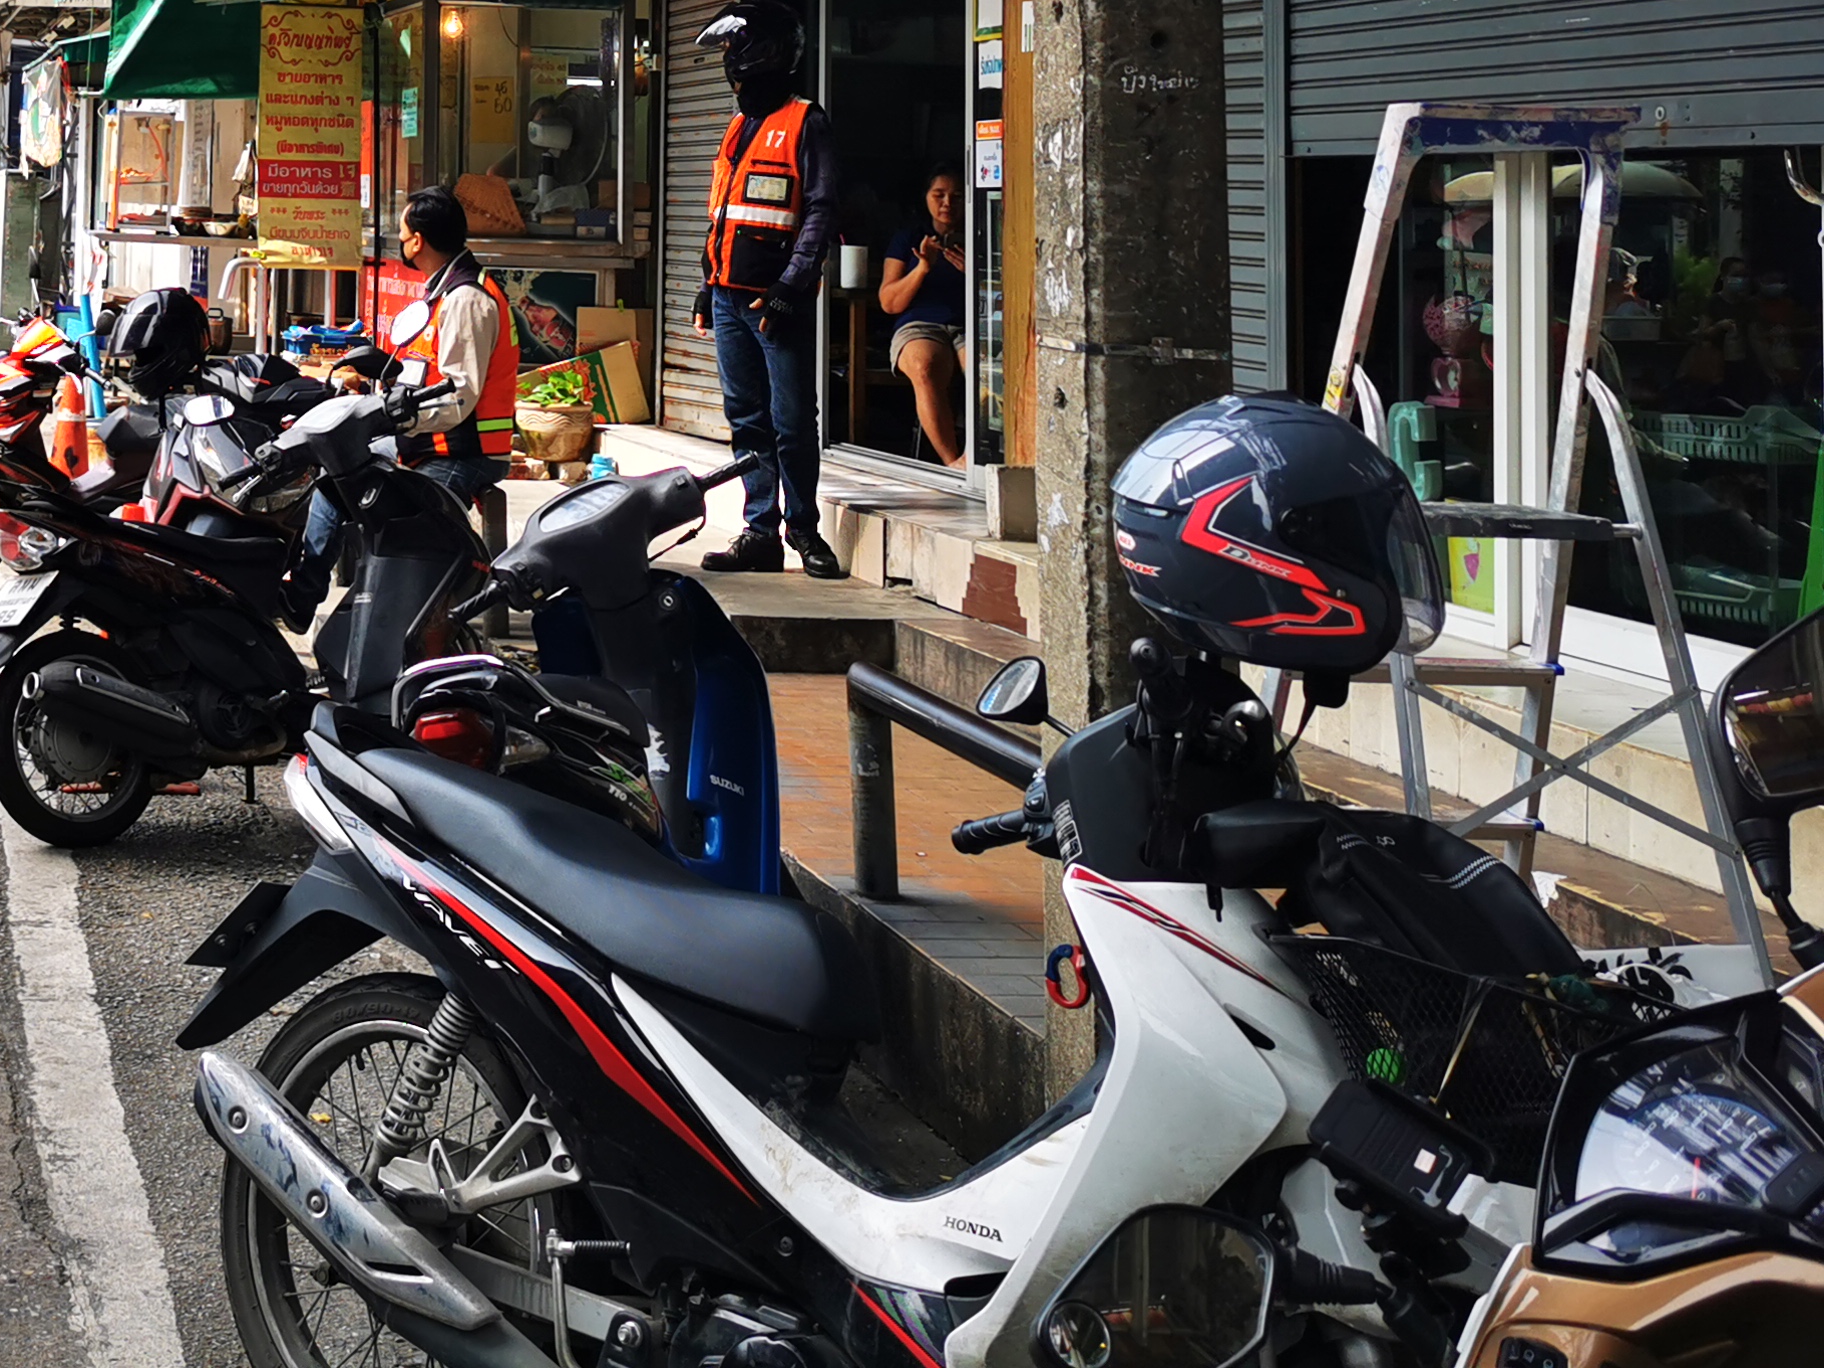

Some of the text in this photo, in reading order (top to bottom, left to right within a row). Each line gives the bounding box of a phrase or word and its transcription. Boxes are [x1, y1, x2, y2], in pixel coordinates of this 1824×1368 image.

[765, 130, 787, 149] 17
[710, 774, 745, 797] SUZUKI
[942, 1215, 1004, 1244] HONDA
